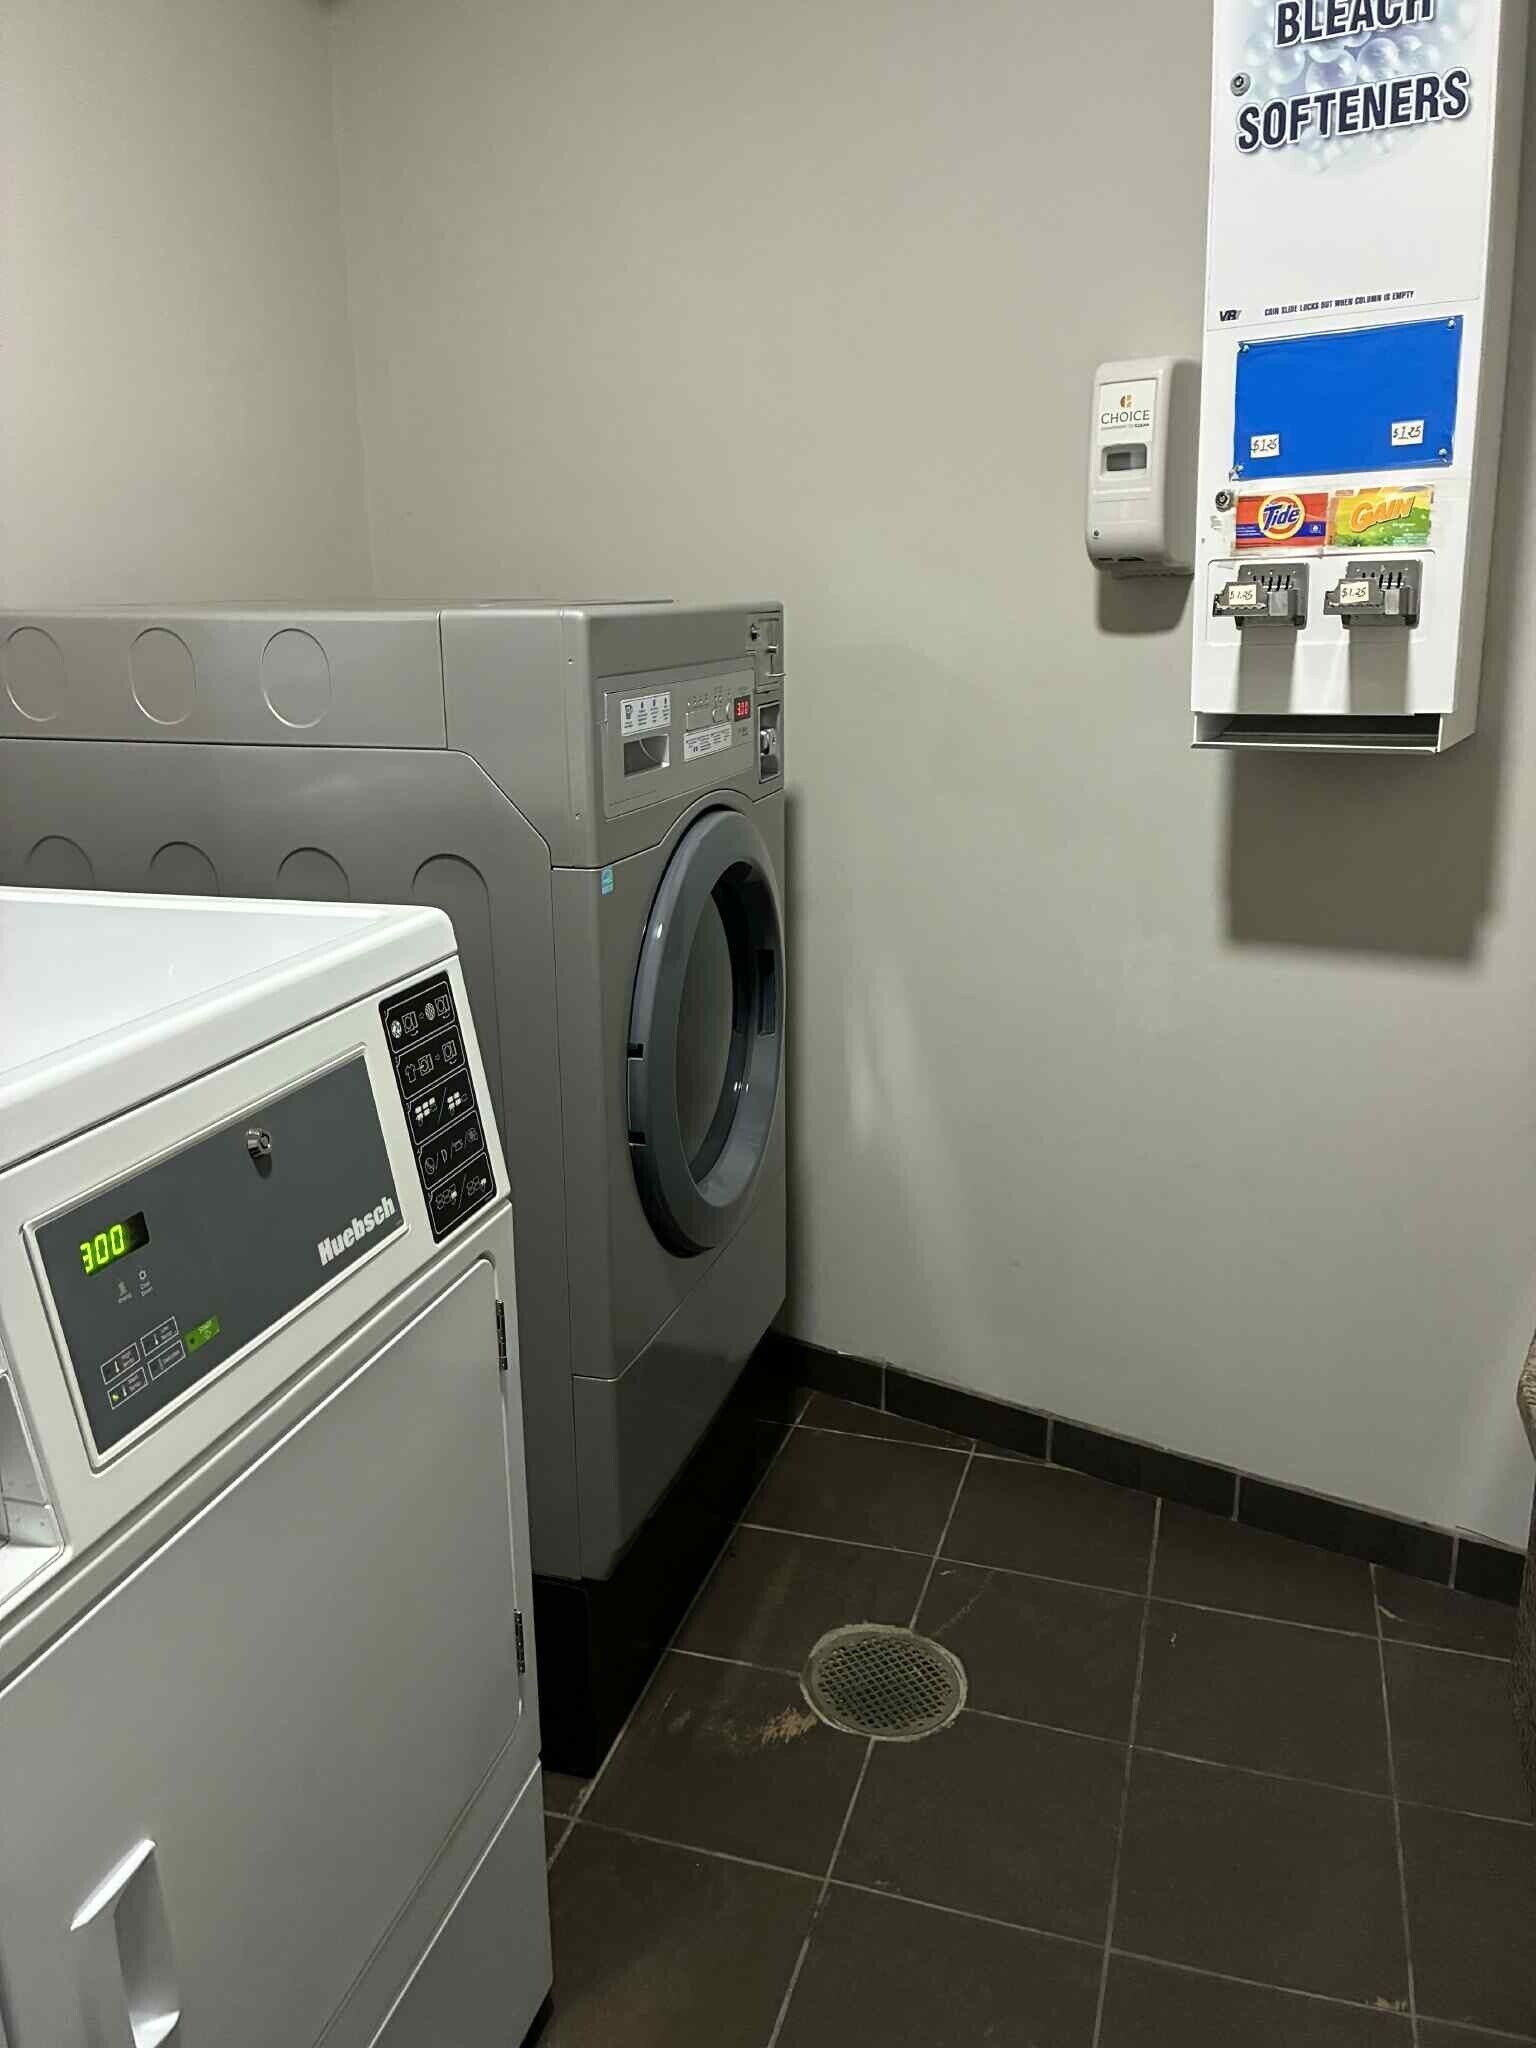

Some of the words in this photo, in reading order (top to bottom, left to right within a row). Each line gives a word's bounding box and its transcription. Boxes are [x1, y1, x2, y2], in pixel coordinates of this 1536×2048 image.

[1238, 70, 1469, 151] SOFTENERS
[1264, 307, 1279, 317] COIN
[1281, 305, 1298, 315] SLIDE
[1299, 302, 1319, 313] LOCKS
[1320, 301, 1333, 309] OUT
[1334, 298, 1353, 308] WHEN
[1354, 294, 1382, 305] COLUMN
[1383, 293, 1391, 301] IS
[1392, 290, 1415, 301] EMPTY
[1101, 410, 1150, 424] CHOICE
[1263, 503, 1300, 531] Tide
[1342, 586, 1367, 600] $1.25
[317, 1195, 396, 1267] Huebsch
[80, 1224, 124, 1274] 300
